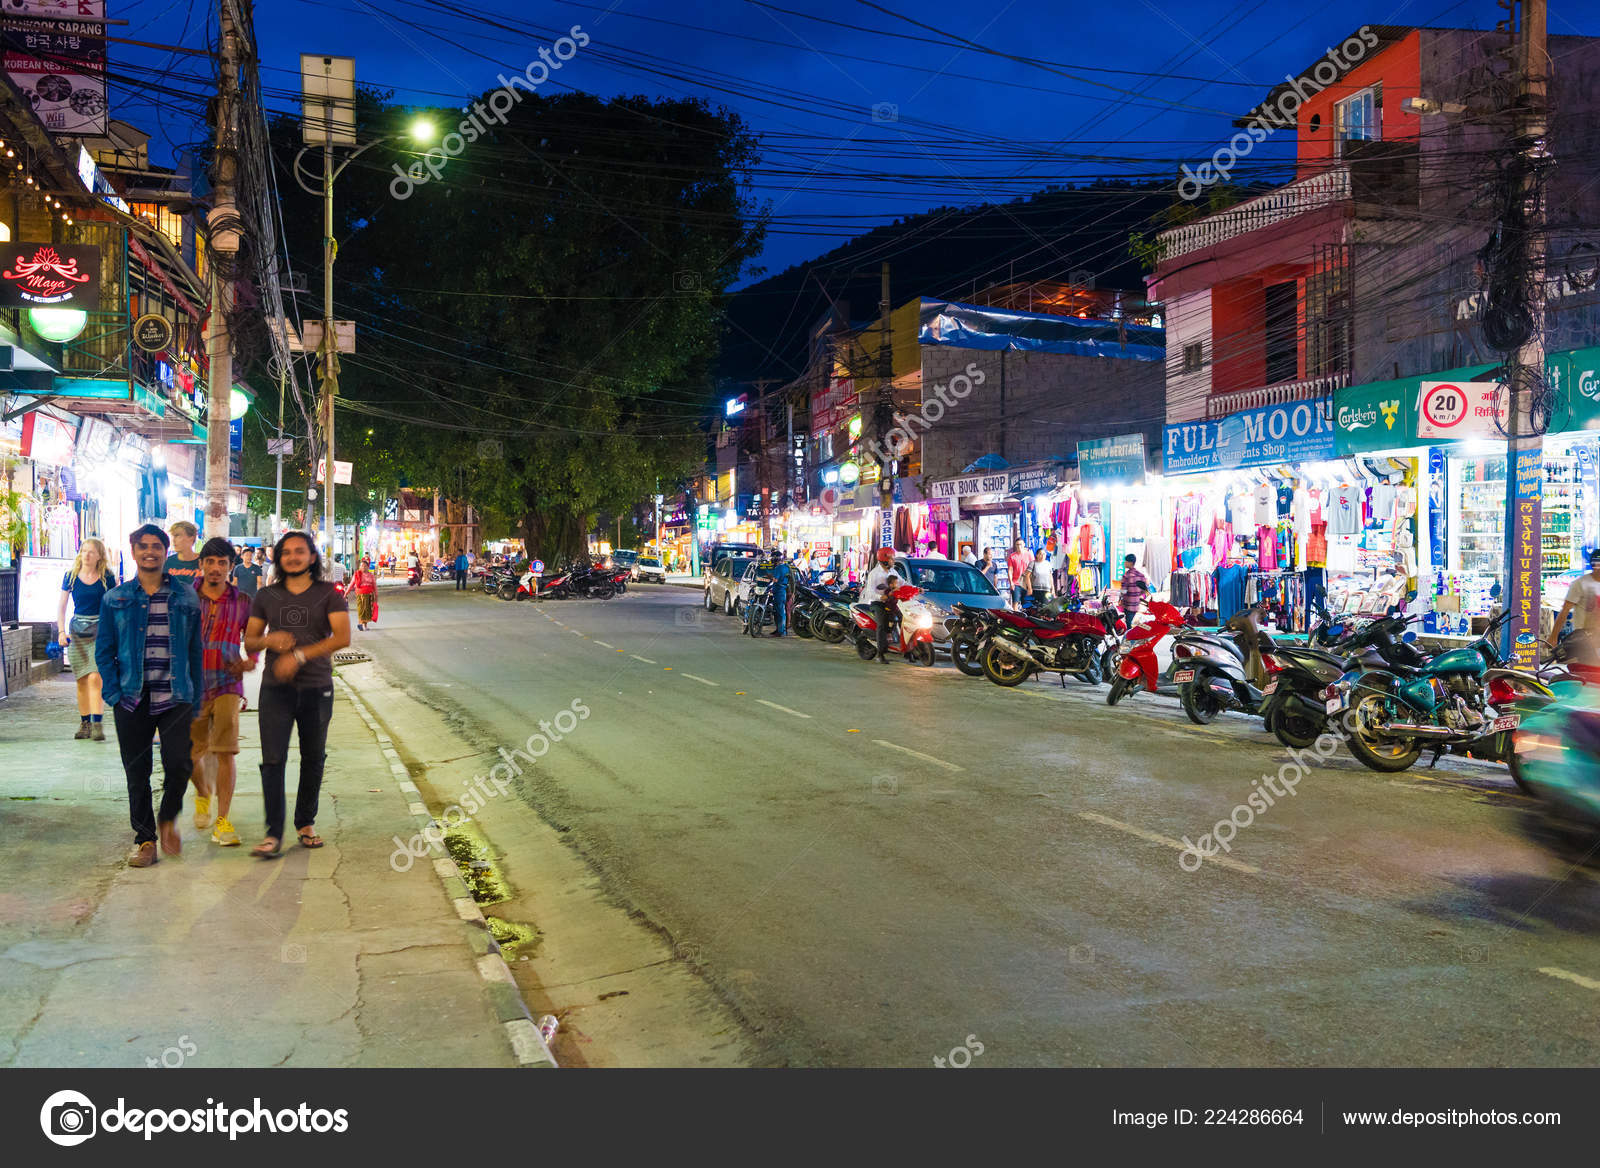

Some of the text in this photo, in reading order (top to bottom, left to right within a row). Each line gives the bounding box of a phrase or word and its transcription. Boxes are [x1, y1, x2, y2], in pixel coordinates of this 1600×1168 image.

[58, 22, 102, 35] SARANG
[25, 34, 81, 49] 한국 사랑
[4, 60, 41, 69] KOREAN
[26, 274, 67, 297] Maya
[1435, 395, 1456, 411] 20
[1338, 404, 1376, 428] Carlsberg
[1167, 400, 1333, 455] FULL MOON
[1110, 442, 1141, 457] HERITAGE
[1168, 454, 1210, 469] Embroidery
[1212, 451, 1218, 462] &
[1219, 448, 1260, 461] Garments
[1262, 443, 1285, 457] Shop
[940, 476, 1006, 496] YAK BOOK SHOP
[747, 508, 780, 516] TAOO
[882, 511, 893, 548] BARBE
